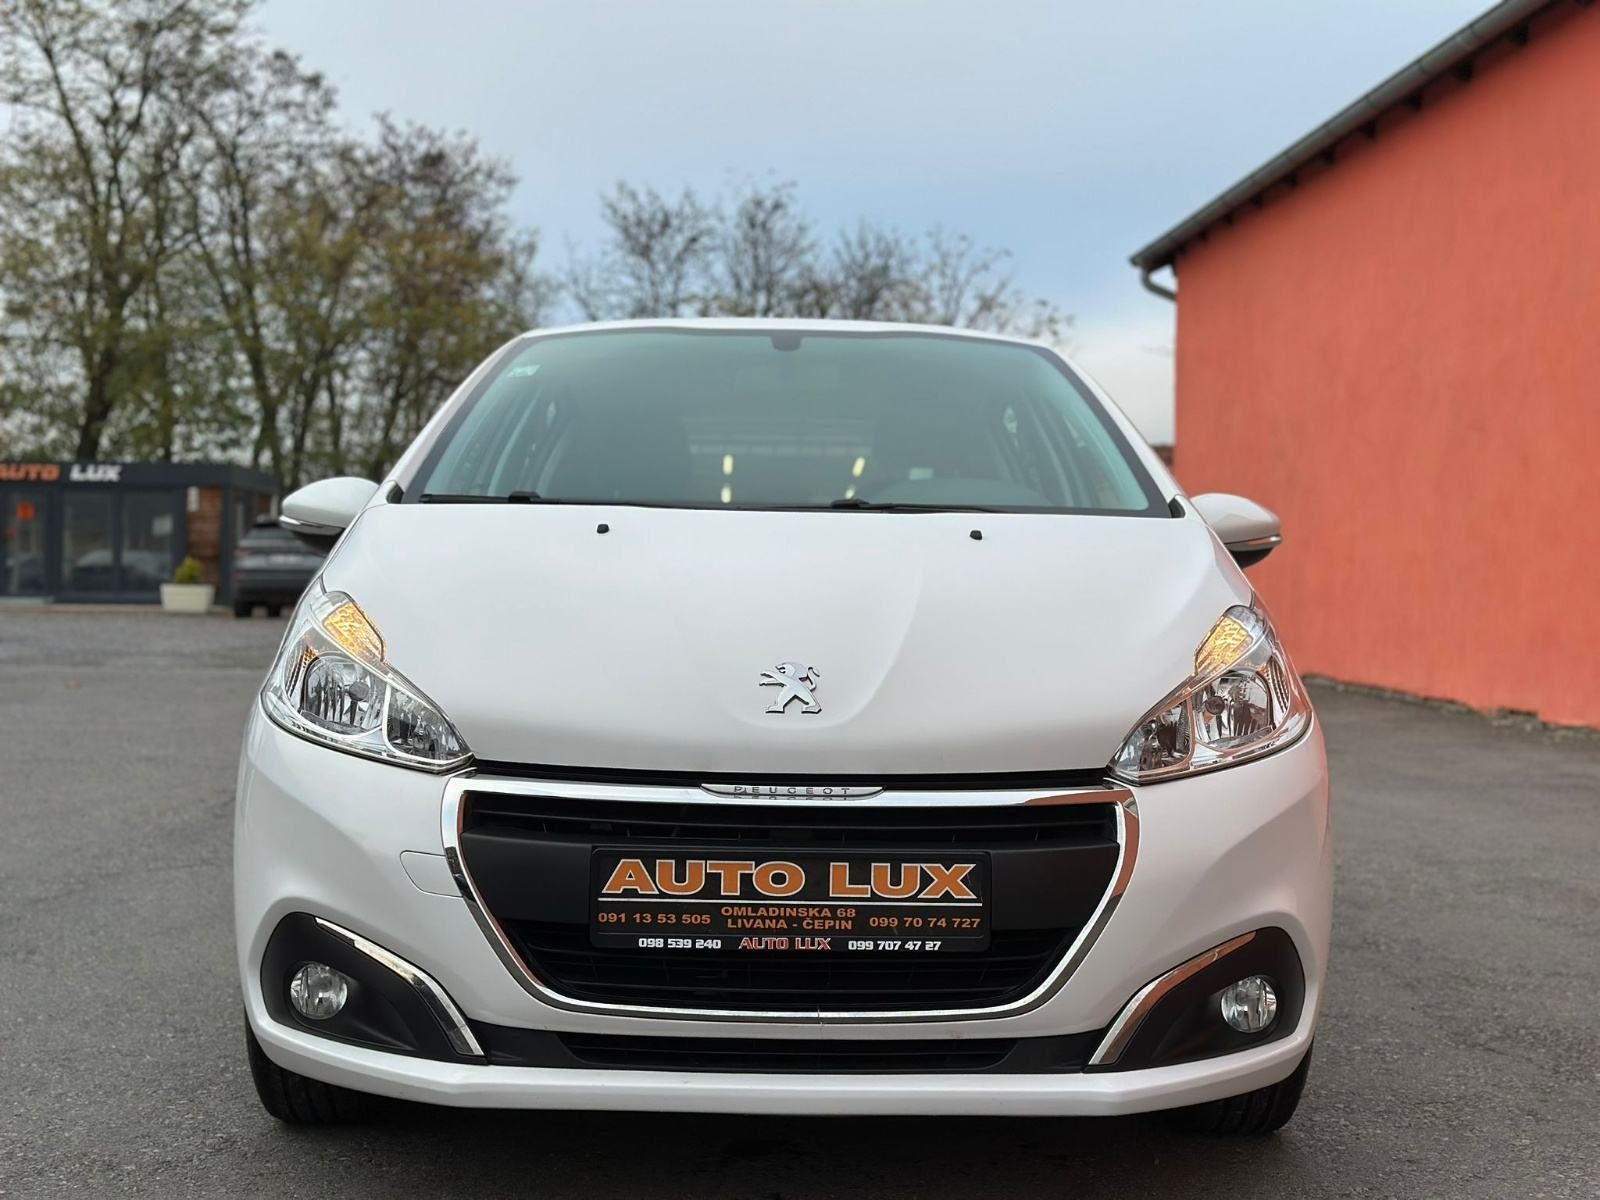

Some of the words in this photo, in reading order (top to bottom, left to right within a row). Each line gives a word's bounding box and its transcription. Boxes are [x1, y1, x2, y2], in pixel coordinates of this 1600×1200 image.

[69, 463, 122, 482] LUX
[734, 786, 850, 795] PEUGEOT
[602, 859, 805, 896] AUTO
[829, 862, 977, 898] LUX
[721, 906, 832, 917] OMLADINSKA
[836, 908, 857, 918] 68
[598, 912, 626, 923] 091
[633, 913, 652, 923] 13
[657, 914, 677, 924] 53
[682, 914, 712, 925] 505
[727, 919, 788, 929] LIVANA
[802, 917, 853, 930] ČEPIN
[869, 917, 898, 927] 099
[903, 918, 923, 928] 70
[927, 918, 947, 928] 74
[951, 918, 981, 928] 727
[638, 938, 664, 948] 098
[667, 939, 693, 949] 539
[695, 939, 722, 949] 240
[738, 937, 789, 950] AUTO
[794, 937, 832, 950] LUX
[848, 940, 874, 951] 099
[877, 941, 902, 951] 707
[904, 941, 922, 951] 47
[925, 941, 942, 951] 27
